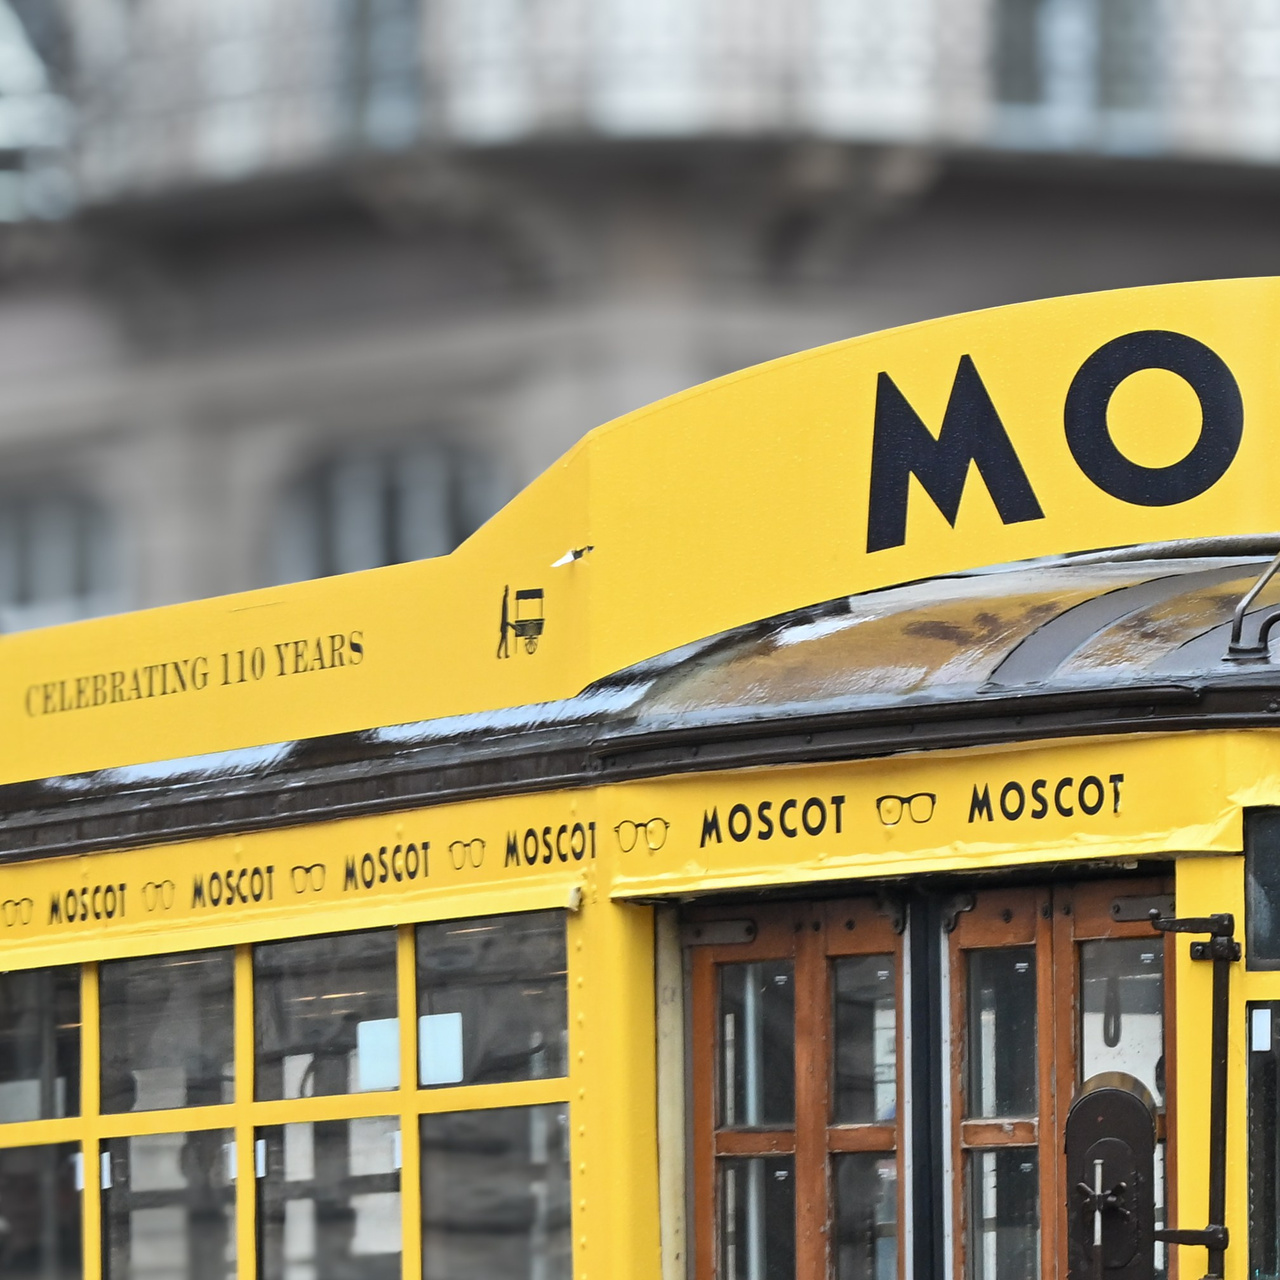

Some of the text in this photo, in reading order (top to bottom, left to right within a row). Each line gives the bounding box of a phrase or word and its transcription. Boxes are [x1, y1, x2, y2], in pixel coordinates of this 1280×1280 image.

[25, 630, 364, 718] CELEBRATING 110 YEARS
[699, 773, 1125, 848] MOSCOT MOSCOT
[47, 821, 597, 926] MOSCOT MOSCOT MOSCOT MOSCOT
